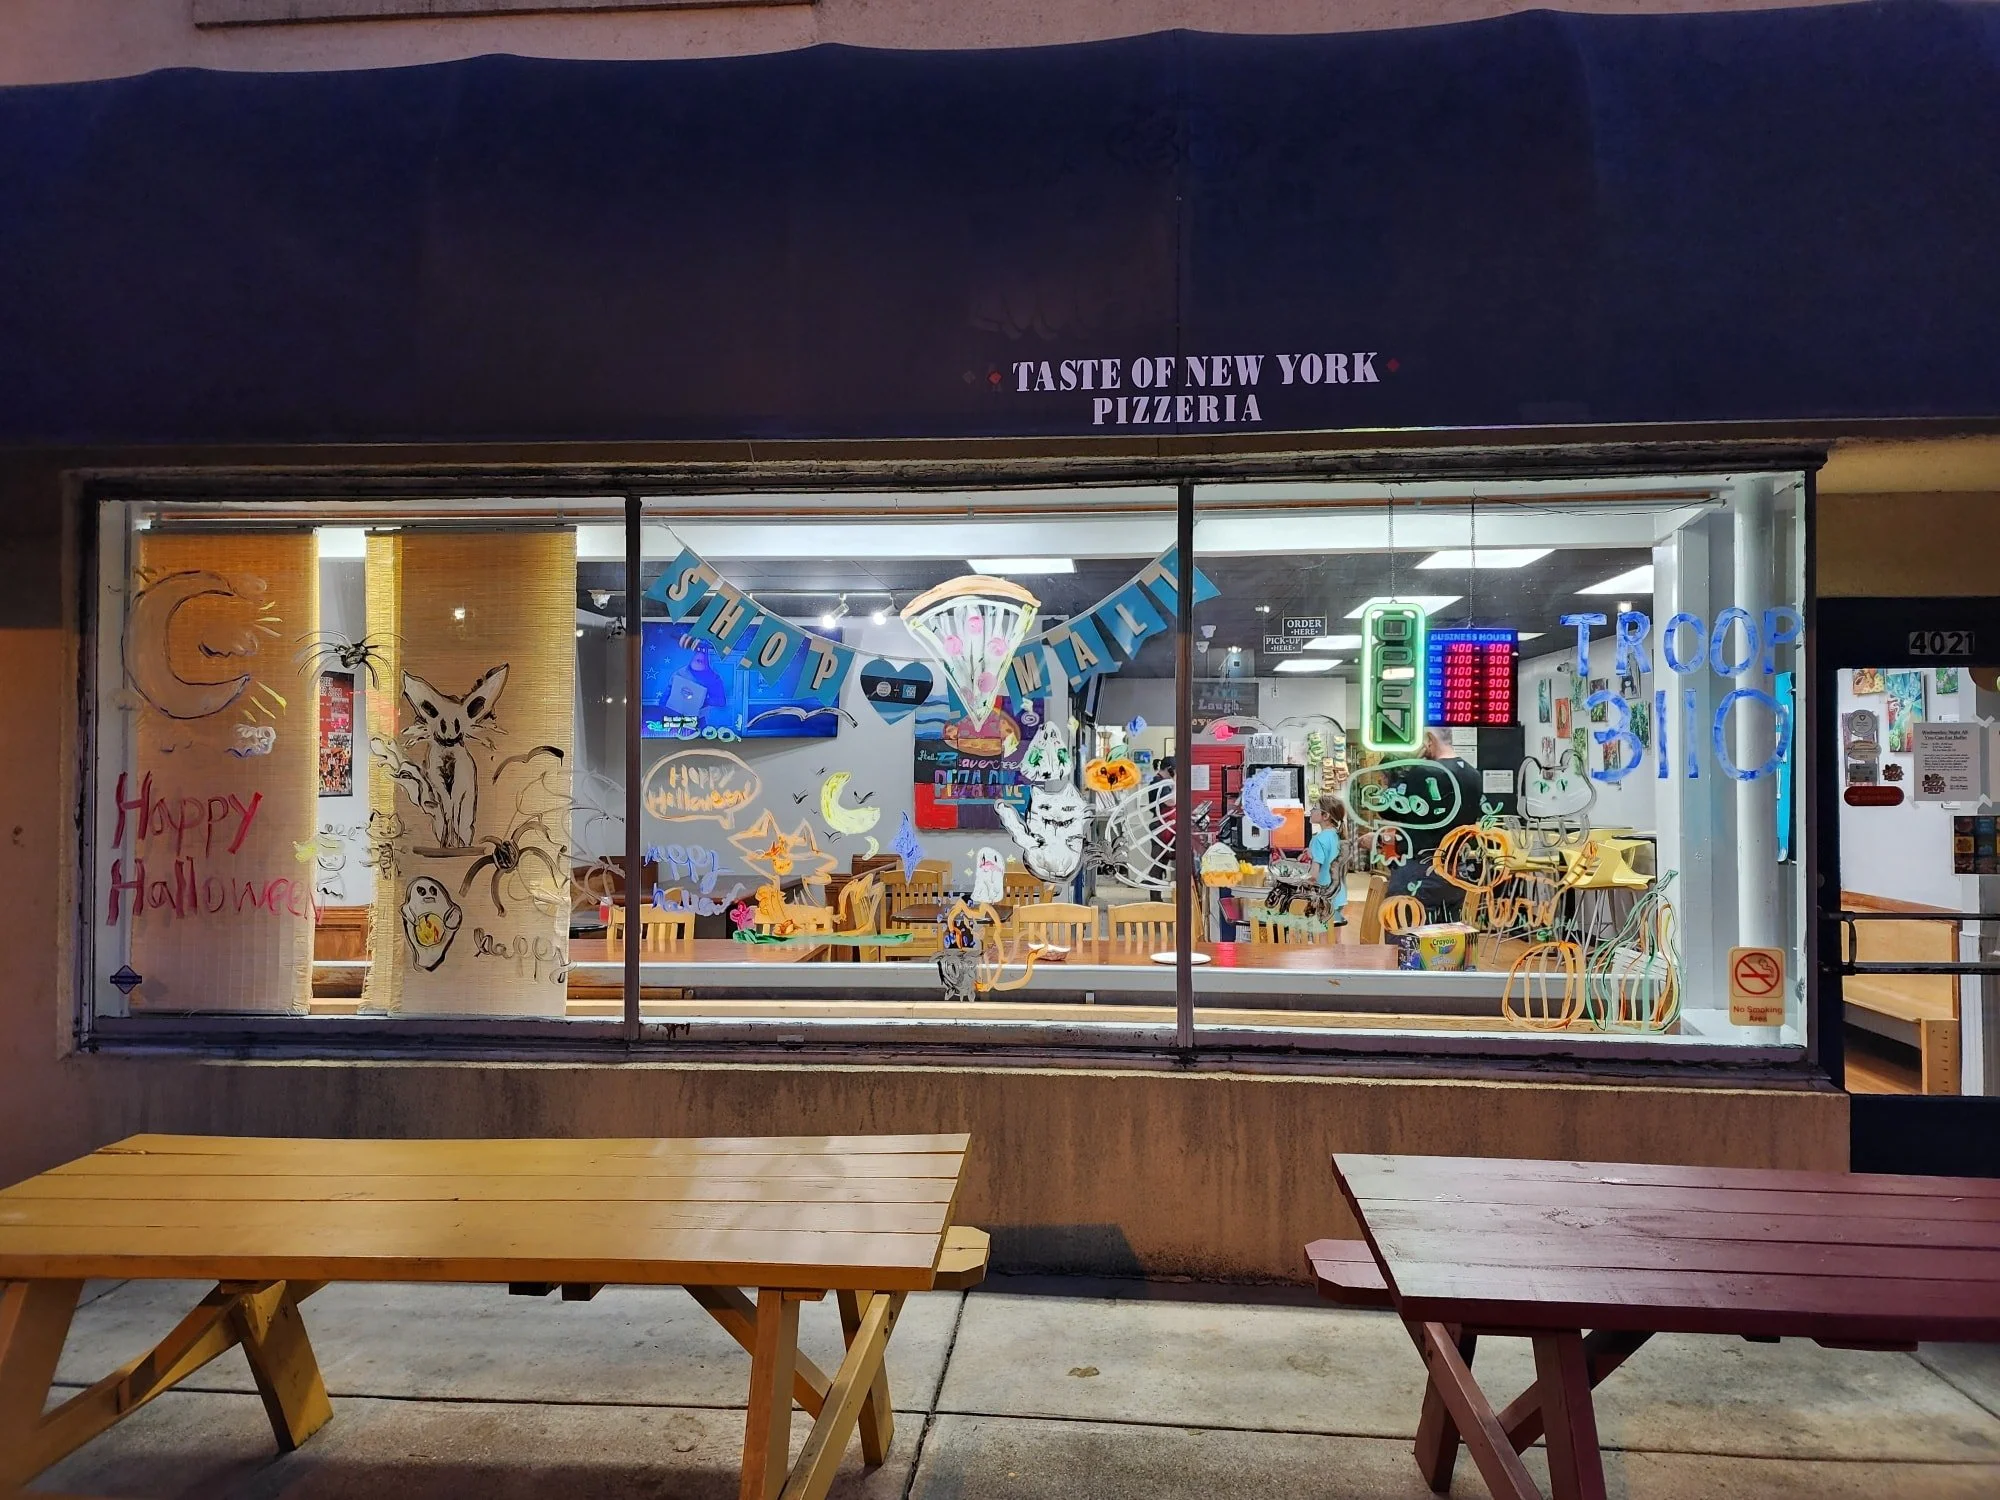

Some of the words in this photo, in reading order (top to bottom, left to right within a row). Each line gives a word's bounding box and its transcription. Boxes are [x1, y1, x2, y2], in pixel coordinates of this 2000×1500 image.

[1012, 357, 1122, 392] TASTE
[1131, 356, 1176, 389] OF
[1185, 354, 1265, 387] NEW
[1276, 352, 1381, 384] YORK
[1092, 394, 1263, 425] PIZZERIA
[666, 567, 839, 690] SHOP
[1286, 619, 1322, 628] ORDER
[1431, 633, 1477, 641] BUSINESS
[1479, 633, 1512, 641] HOURS
[1265, 637, 1300, 645] PICK-UP
[1559, 606, 1801, 679] TROOP
[1910, 631, 1975, 655] 4021
[1376, 614, 1413, 743] OPEN
[1585, 687, 1791, 782] 3110
[1361, 777, 1447, 815] Boo!
[112, 770, 264, 859] Happy
[1432, 938, 1456, 947] Crayola
[1733, 1005, 1745, 1013] No
[1747, 1005, 1783, 1015] Smoking
